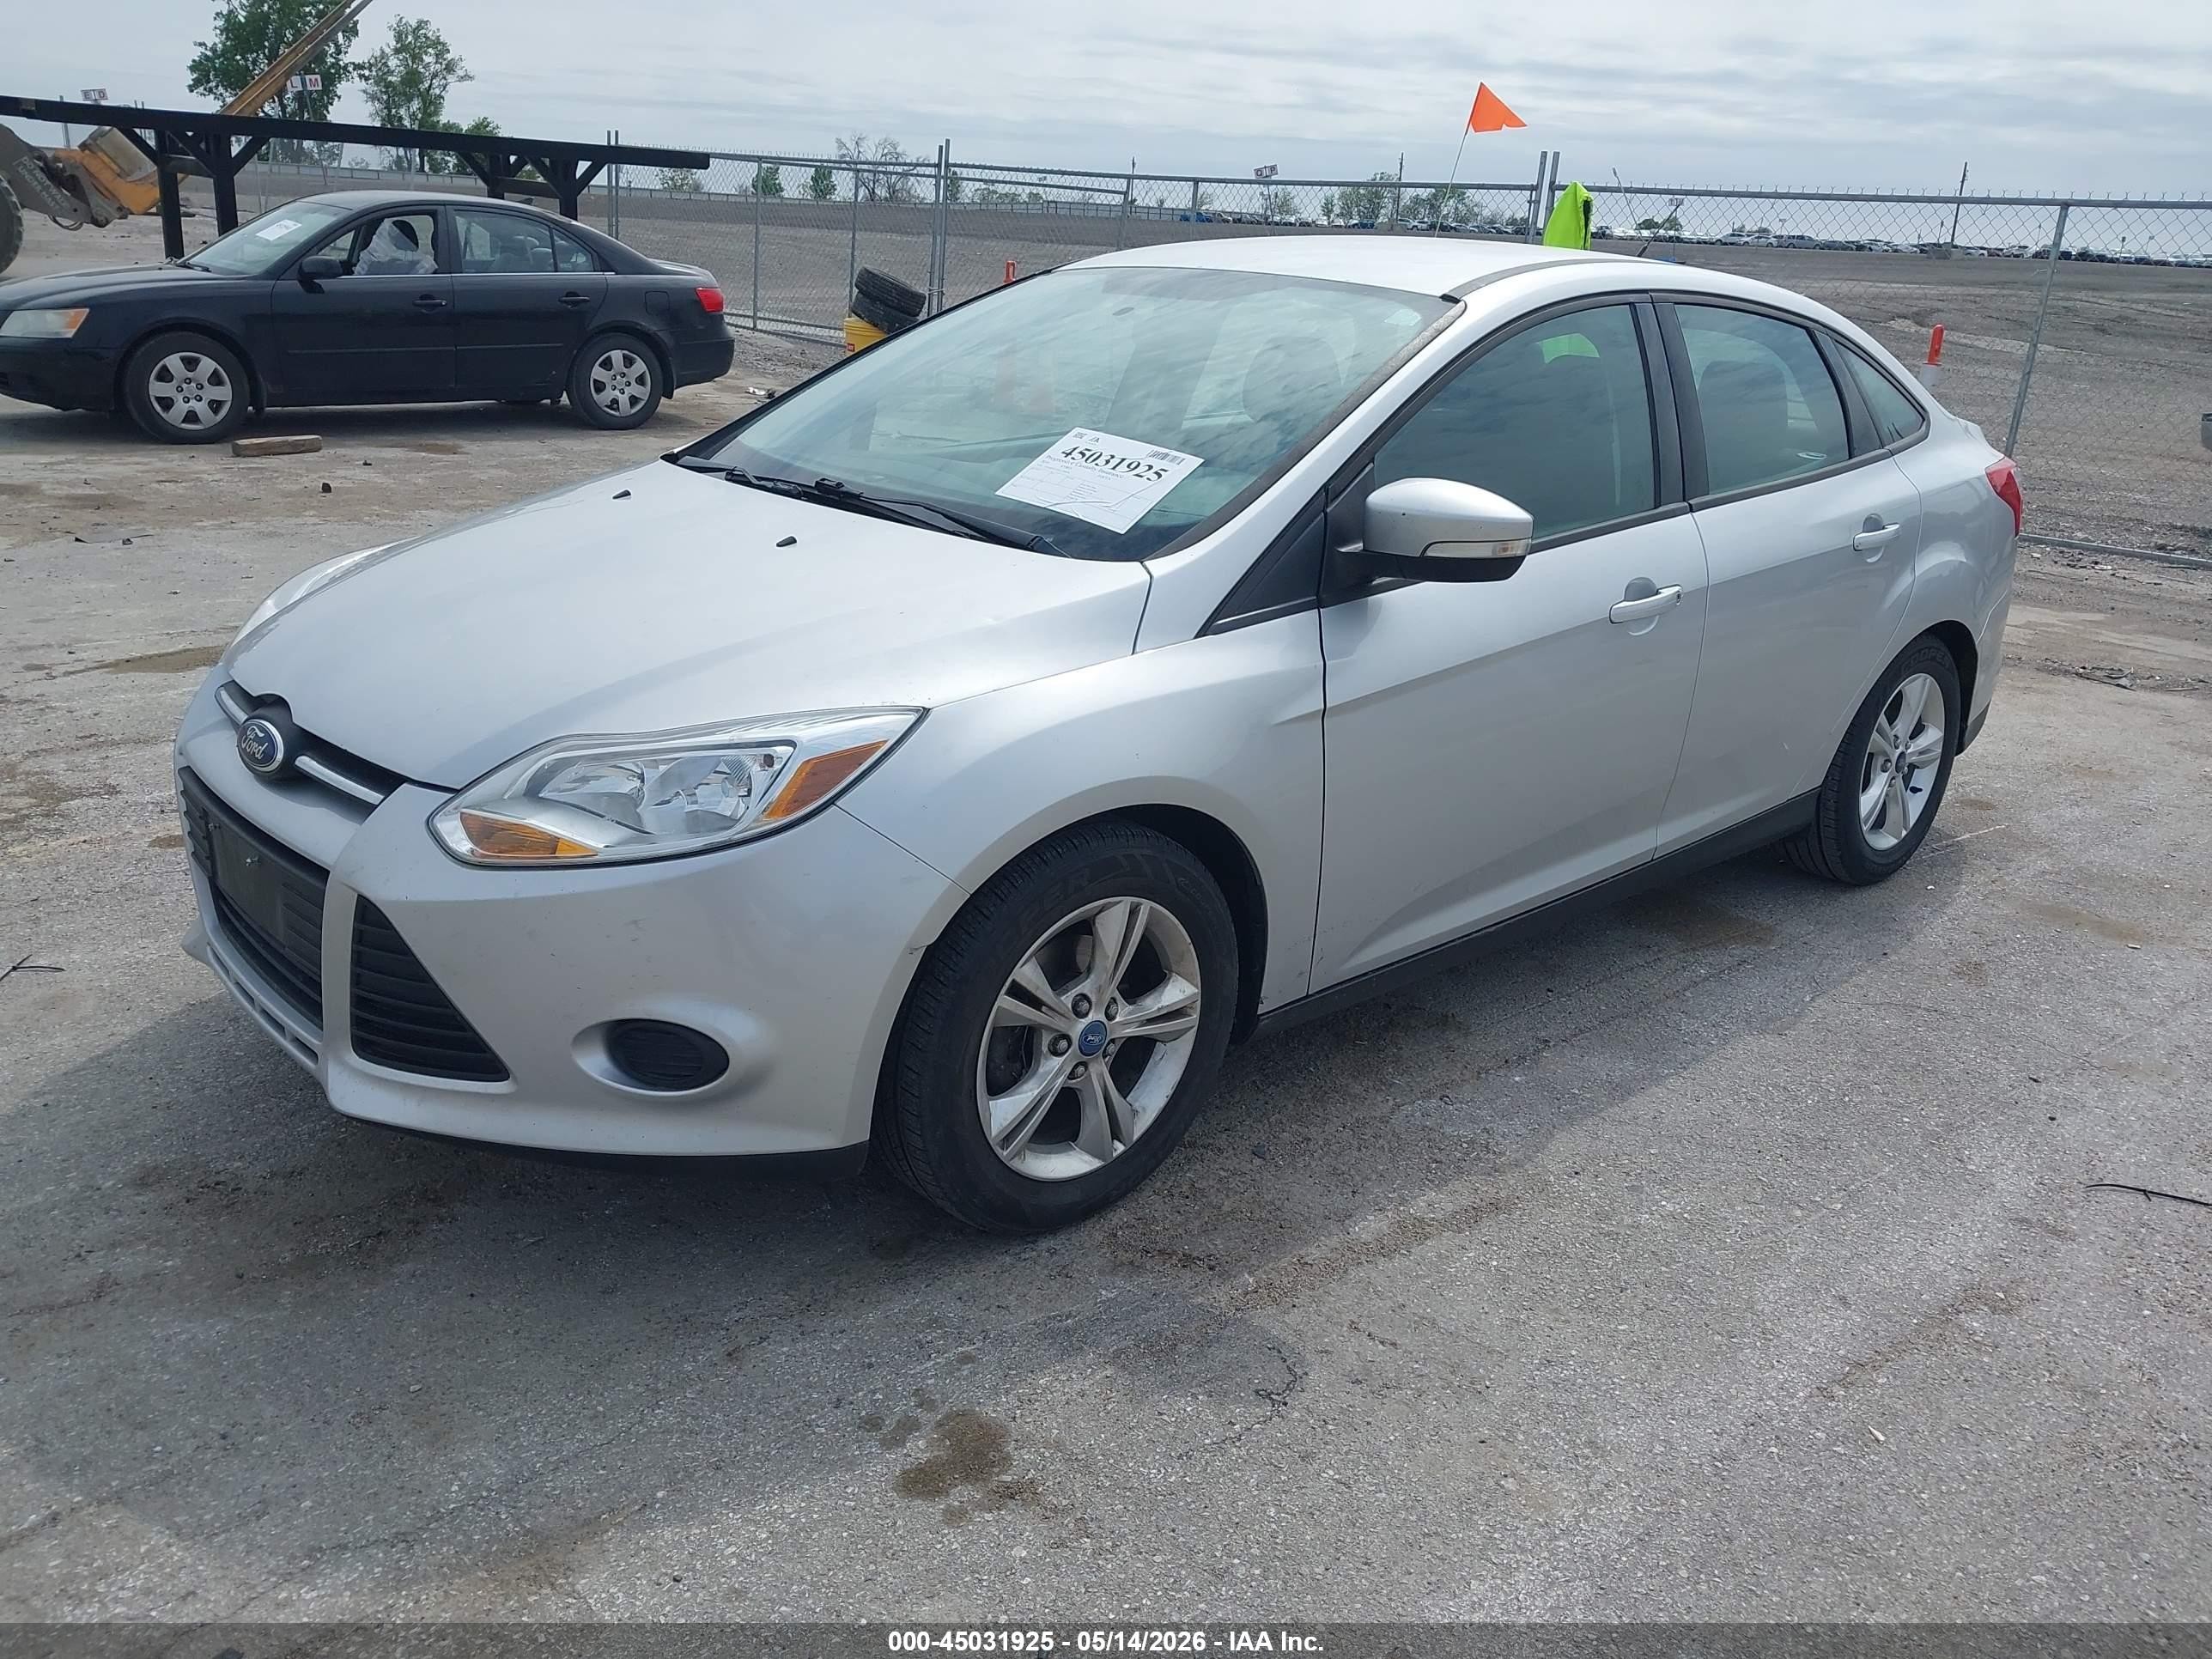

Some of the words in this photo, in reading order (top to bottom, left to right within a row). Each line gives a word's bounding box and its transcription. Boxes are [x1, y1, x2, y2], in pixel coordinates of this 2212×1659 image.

[308, 77, 319, 88] M
[84, 91, 90, 100] E
[98, 90, 105, 99] D
[1061, 446, 1169, 483] 45031925
[240, 725, 268, 759] Ford
